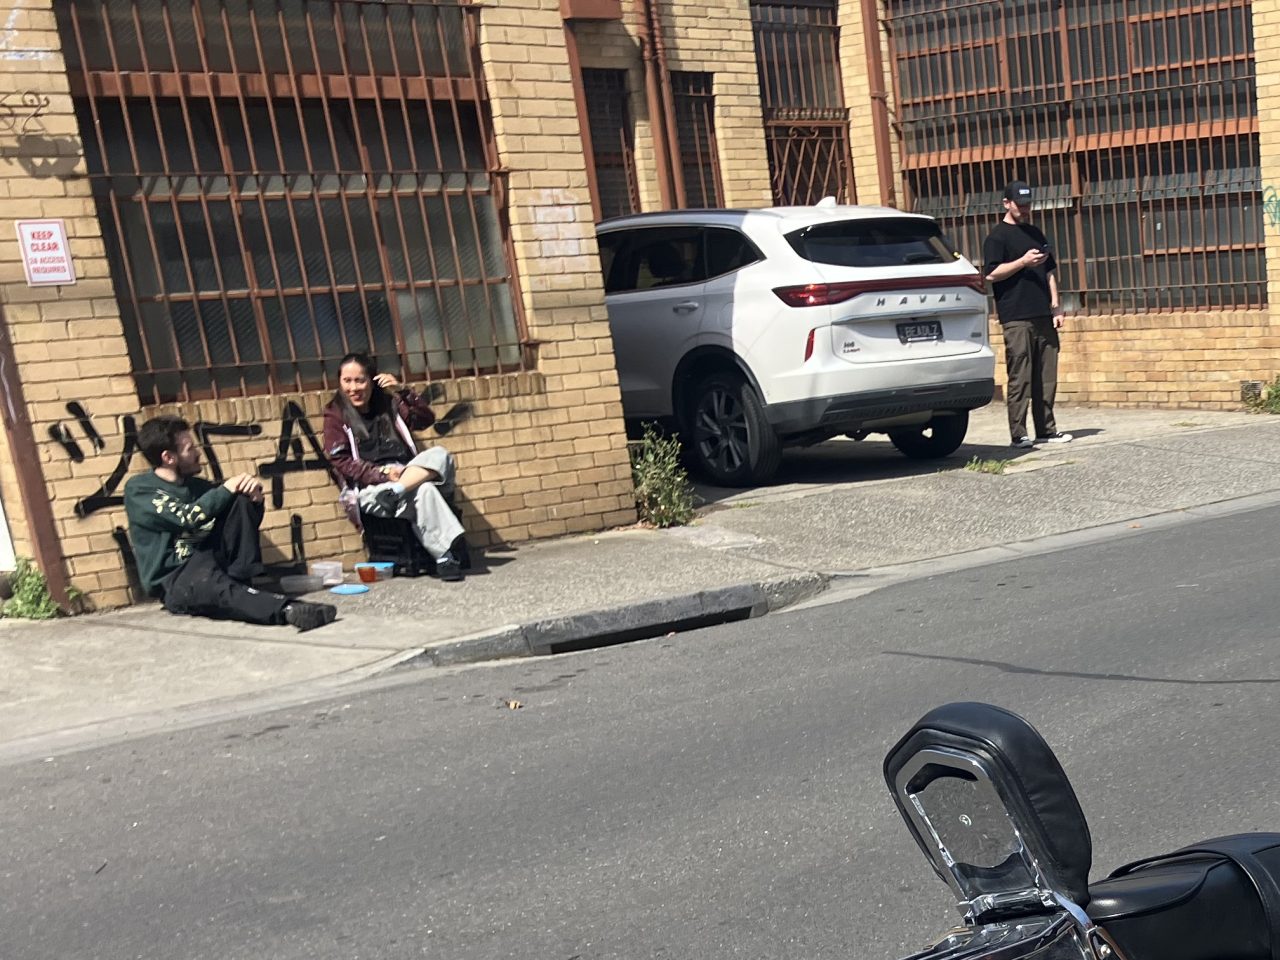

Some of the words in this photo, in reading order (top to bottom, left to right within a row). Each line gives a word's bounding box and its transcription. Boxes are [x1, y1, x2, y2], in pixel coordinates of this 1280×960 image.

[31, 230, 54, 240] KEEP
[31, 242, 59, 252] CLEAR
[876, 293, 962, 306] HAVAL
